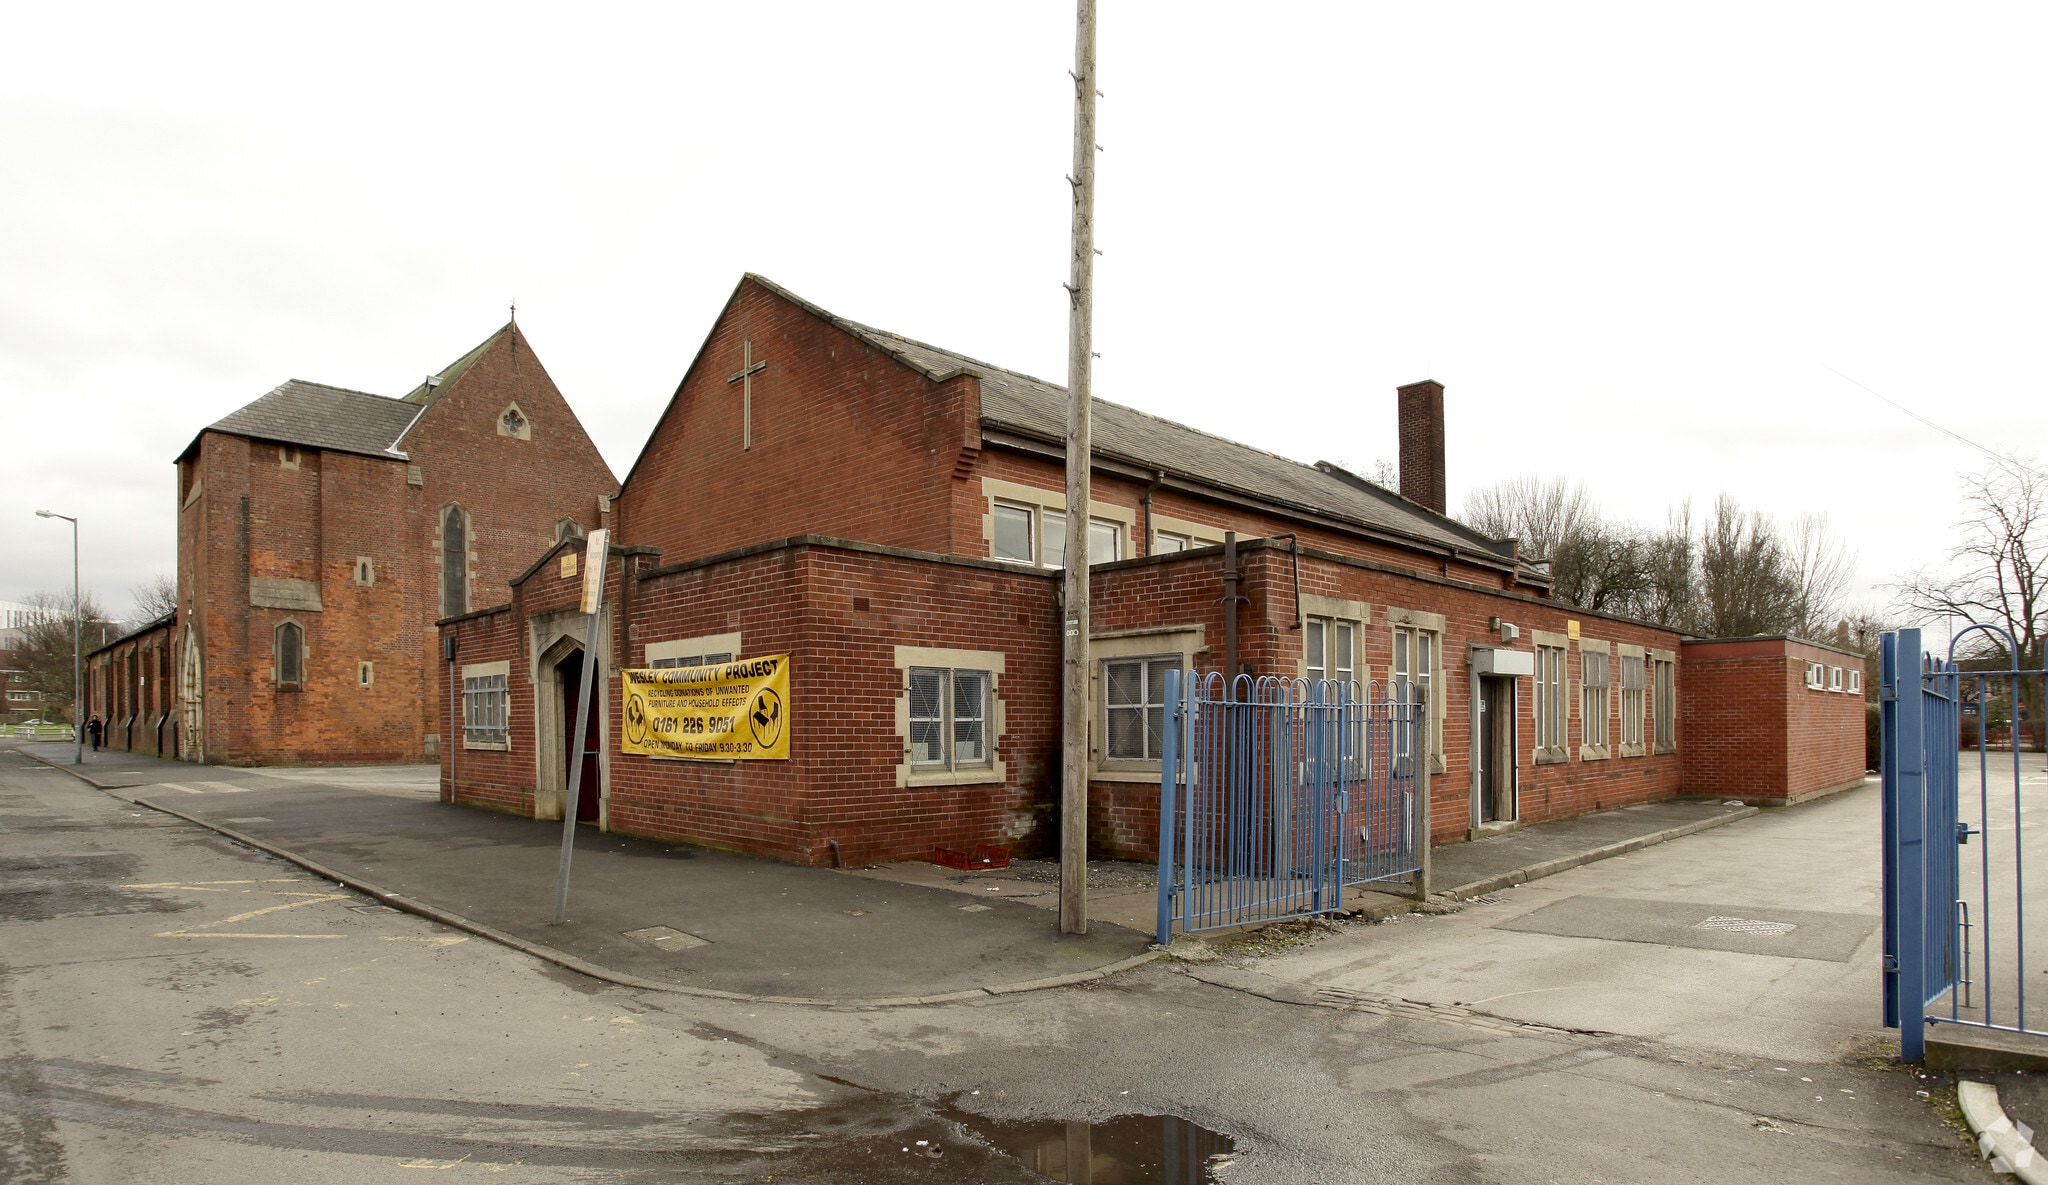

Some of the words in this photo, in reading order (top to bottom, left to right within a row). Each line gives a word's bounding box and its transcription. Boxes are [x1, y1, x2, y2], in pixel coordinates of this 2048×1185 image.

[628, 671, 660, 684] WESLEY
[662, 667, 721, 684] COMMUNITY
[725, 659, 778, 680] PROJECT
[648, 689, 674, 697] RECYCLING
[674, 688, 704, 697] DONATIONS
[705, 687, 713, 696] OF
[716, 684, 750, 695] UNWANTED
[648, 699, 676, 707] FURNITURE
[677, 699, 687, 707] AND
[688, 699, 719, 707] HOUSEHOLD
[722, 697, 747, 707] EFFECTS
[652, 717, 678, 733] 0161
[683, 717, 703, 733] 226
[709, 716, 735, 733] 9051
[643, 739, 659, 749] OPEN
[660, 740, 682, 751] MONDAY
[685, 742, 693, 752] TO
[695, 742, 717, 753] FRIDAY
